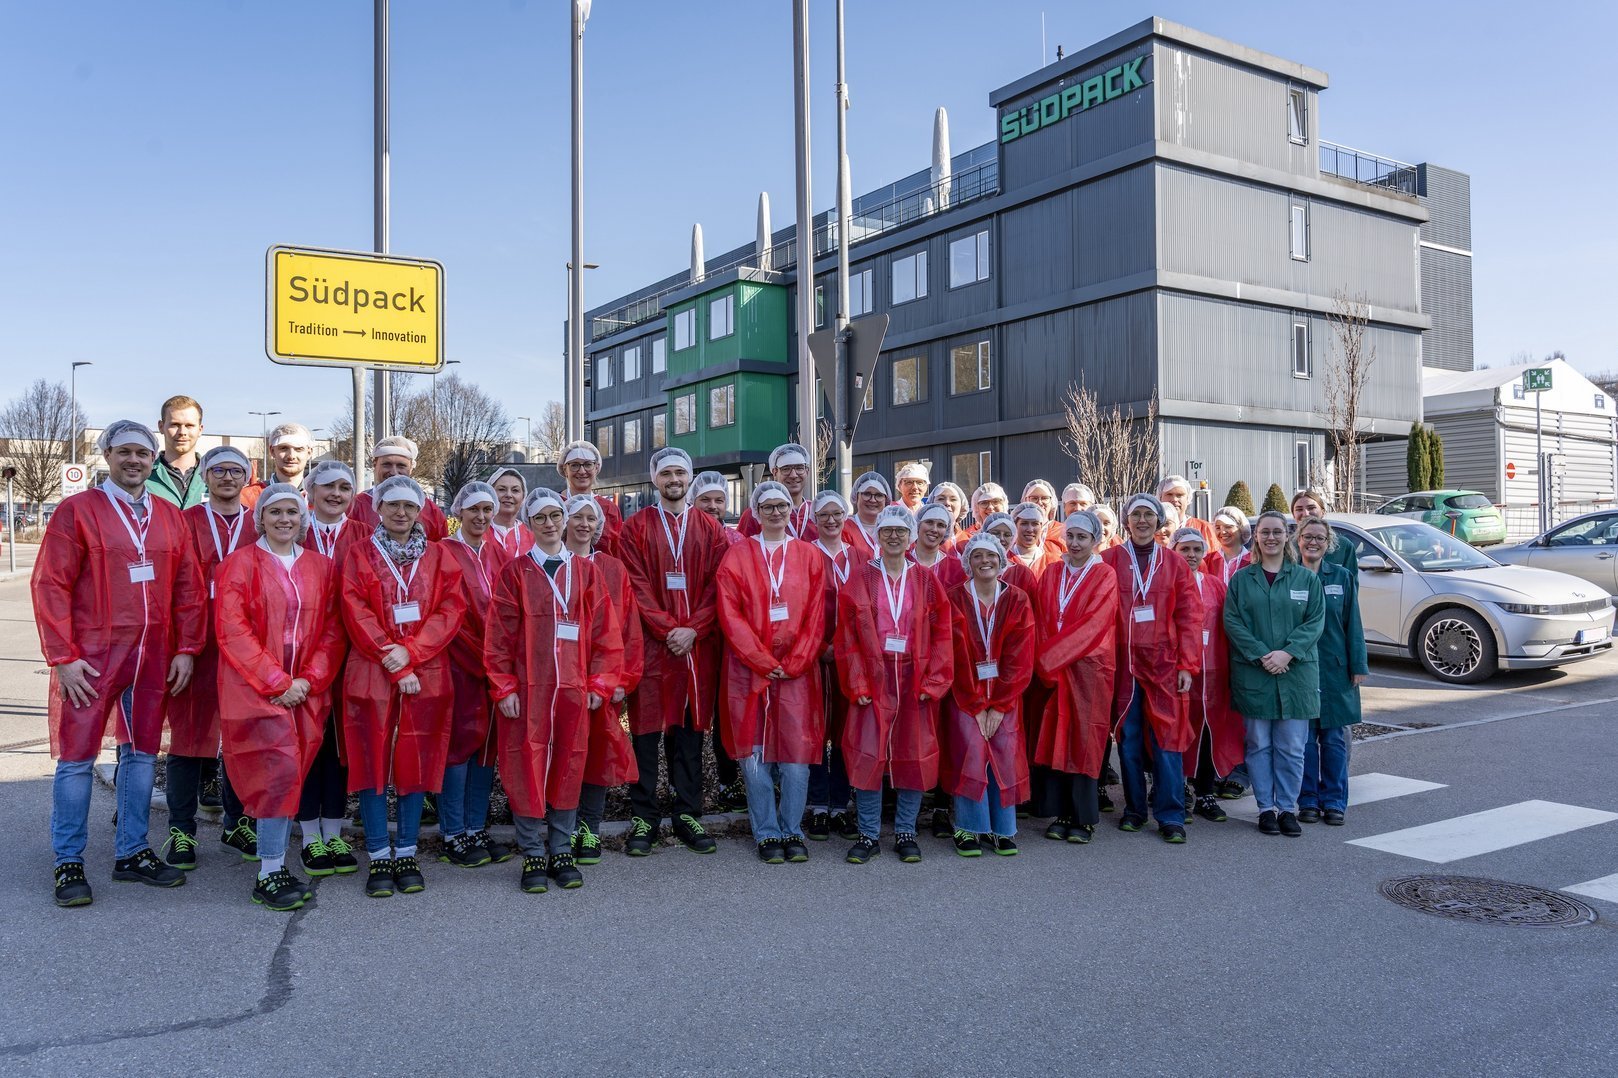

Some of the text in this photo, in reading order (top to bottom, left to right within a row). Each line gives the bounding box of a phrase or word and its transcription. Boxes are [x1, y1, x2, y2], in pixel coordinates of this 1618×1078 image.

[1001, 55, 1145, 143] SÜDPACK
[288, 275, 426, 314] Südpack
[288, 321, 427, 344] Tradition Innovation
[1190, 461, 1203, 470] Tor
[70, 471, 79, 479] 10
[1194, 471, 1198, 479] 1
